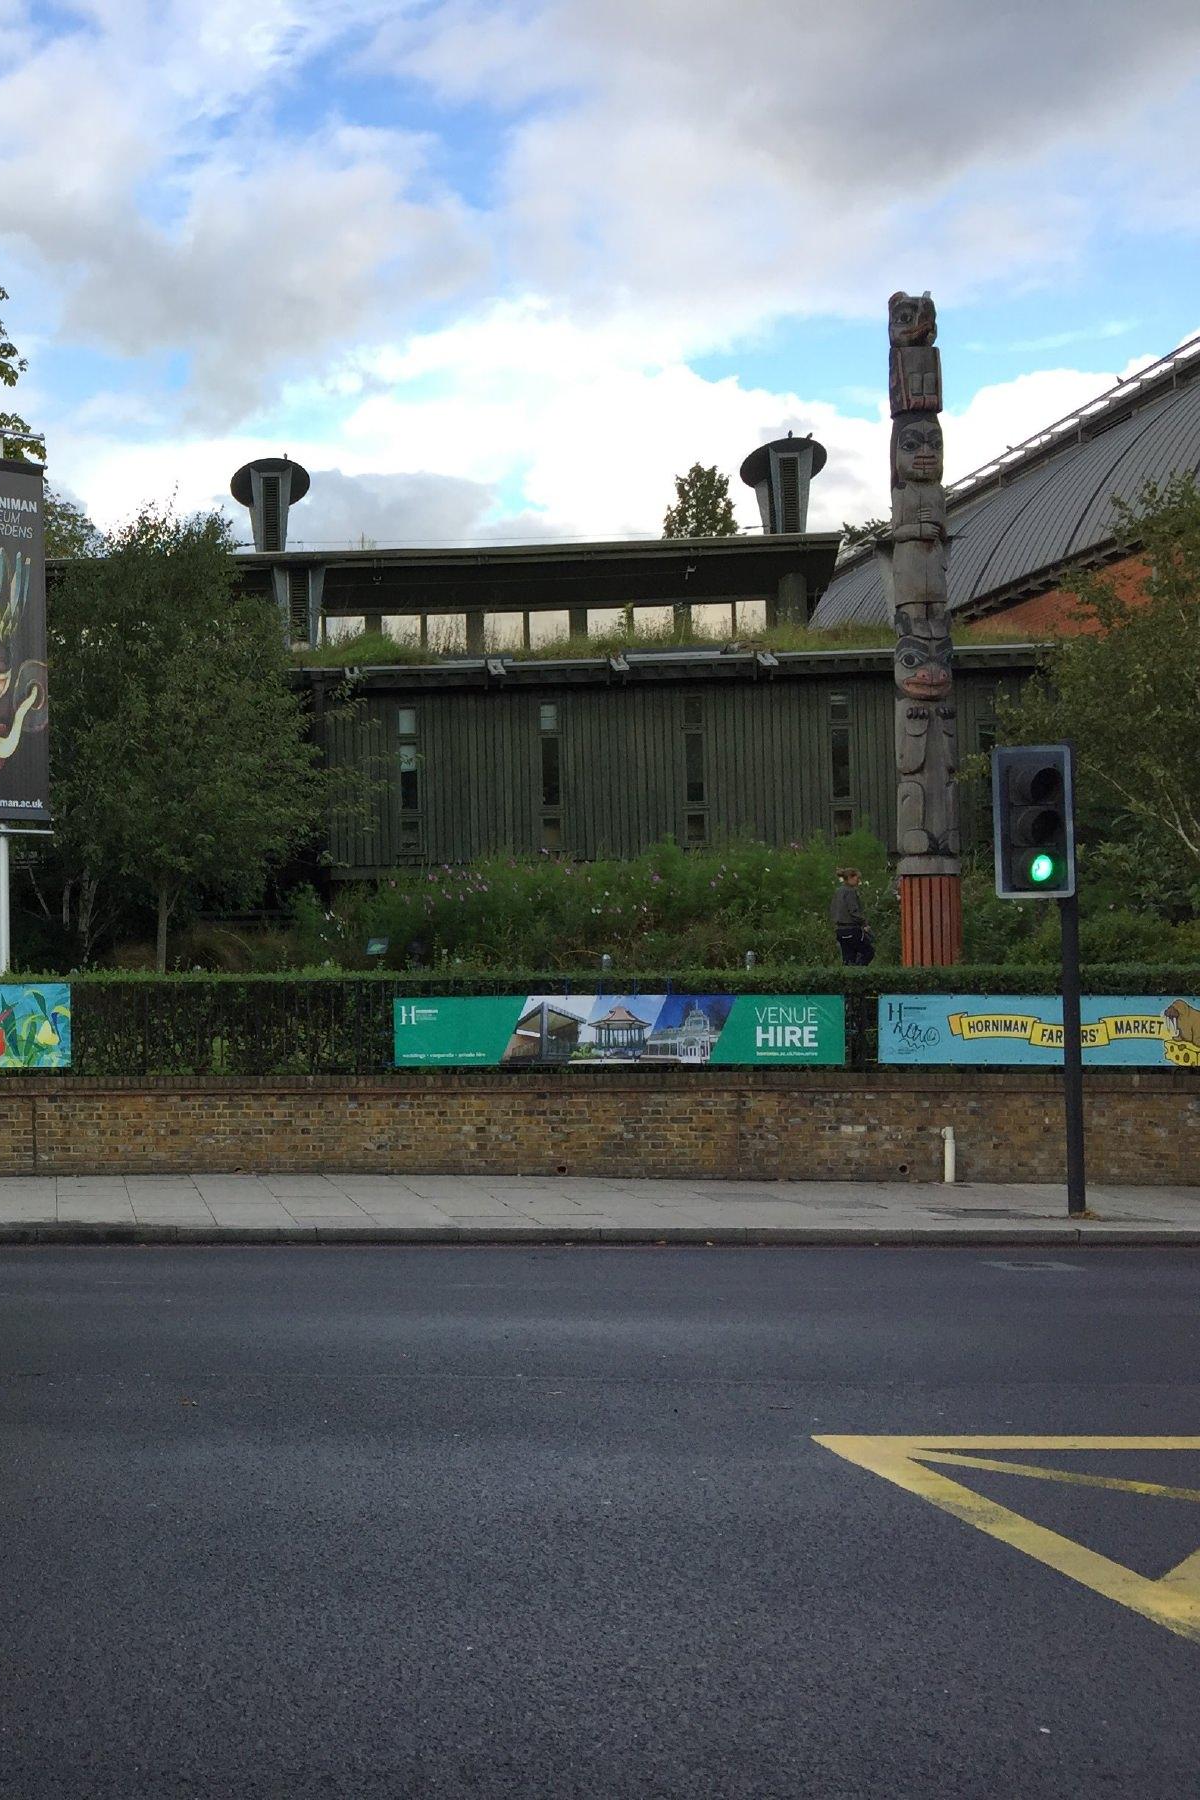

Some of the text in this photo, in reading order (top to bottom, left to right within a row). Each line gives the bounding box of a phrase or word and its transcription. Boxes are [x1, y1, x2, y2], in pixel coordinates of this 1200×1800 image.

[754, 1007, 818, 1023] VENUE
[756, 1026, 818, 1047] HIRE
[967, 1020, 1164, 1043] HORNIMAN FARRS' MARKET
